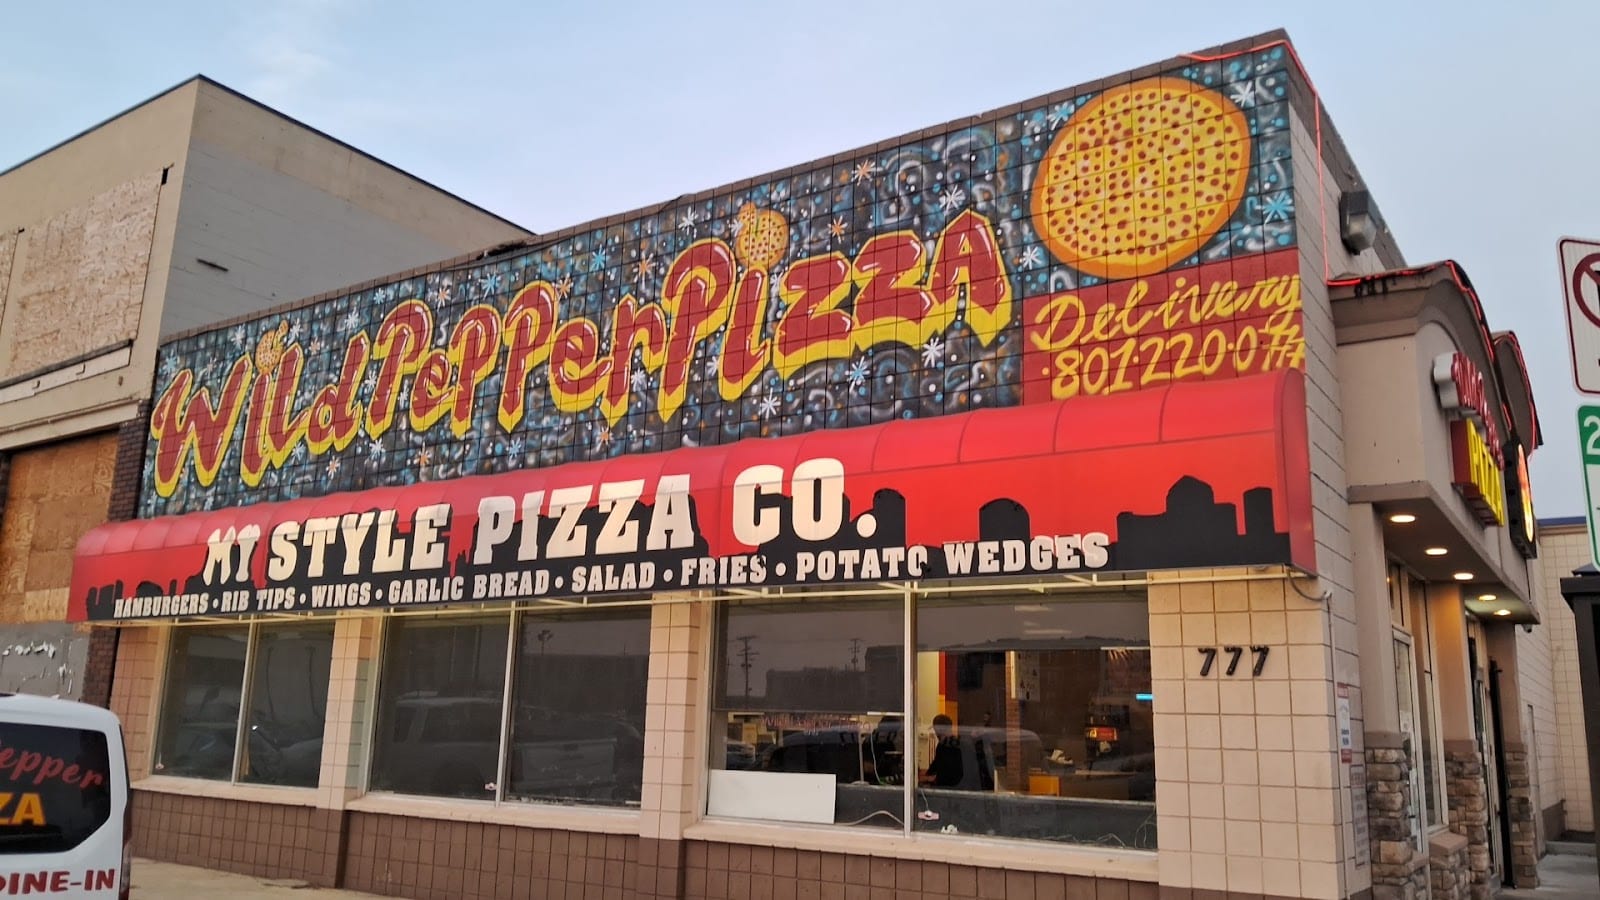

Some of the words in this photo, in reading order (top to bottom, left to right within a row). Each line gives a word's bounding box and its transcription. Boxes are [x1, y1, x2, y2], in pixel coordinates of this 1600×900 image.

[202, 523, 261, 586] MY
[267, 503, 451, 582] STYLE
[473, 473, 695, 566] PIZZA
[732, 457, 877, 547] CO.
[113, 593, 209, 618] HAMBURGERS
[220, 590, 249, 613] RIB
[256, 587, 296, 611] TIPS
[311, 582, 371, 608] WINGS
[388, 575, 465, 605] GARLIC
[473, 569, 550, 599] BREAD
[571, 561, 656, 593] SALAD
[680, 554, 768, 586] FRIES
[796, 545, 929, 582] POTATO
[943, 532, 1110, 575] WEDGES
[1197, 645, 1270, 677] 777
[0, 740, 104, 788] epper
[0, 868, 116, 896] INE-IN
